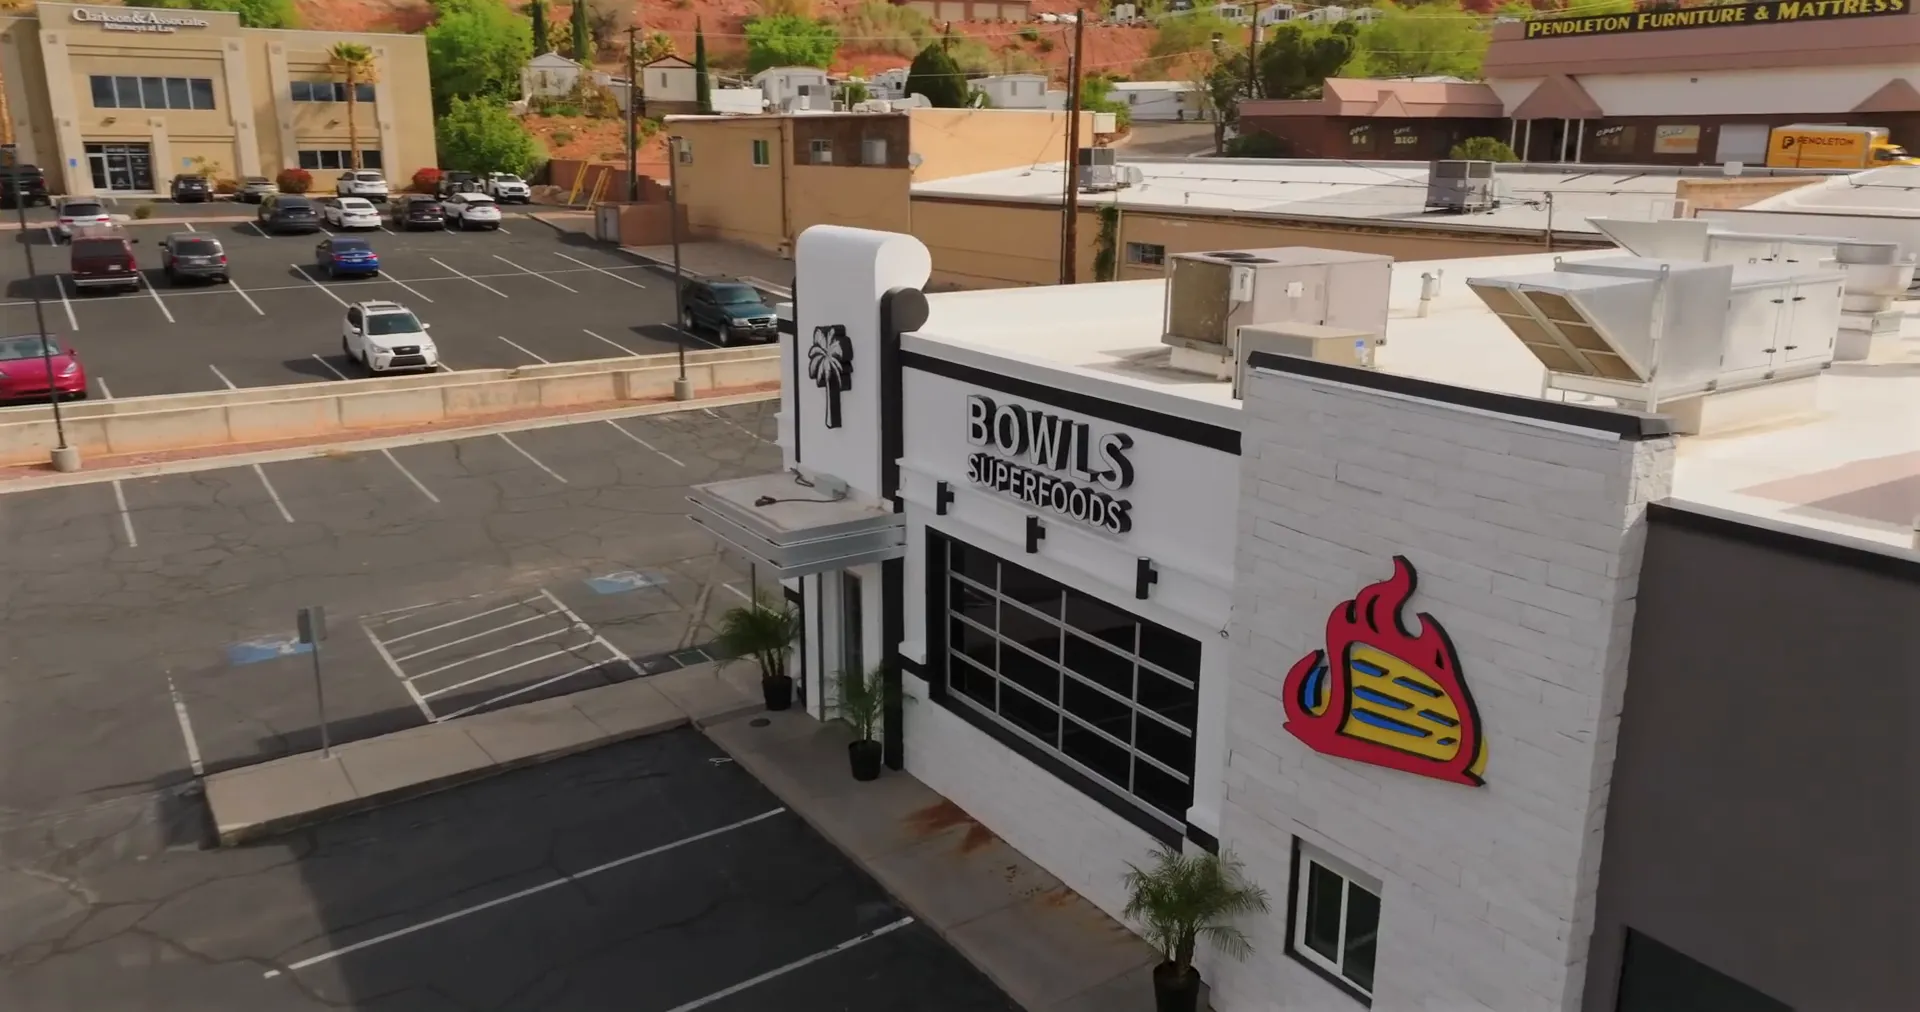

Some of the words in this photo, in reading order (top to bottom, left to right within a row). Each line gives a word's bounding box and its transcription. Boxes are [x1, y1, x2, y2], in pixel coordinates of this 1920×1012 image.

[1528, 17, 1630, 38] PENDLETON
[1637, 7, 1746, 30] FURNITURE
[1753, 5, 1769, 20] &
[1776, 0, 1904, 20] MATTRESS
[1595, 125, 1624, 137] OPEN
[1797, 135, 1855, 147] PENDLETON
[967, 394, 1134, 491] BOWLS
[967, 453, 1132, 534] SUPERFOODS
